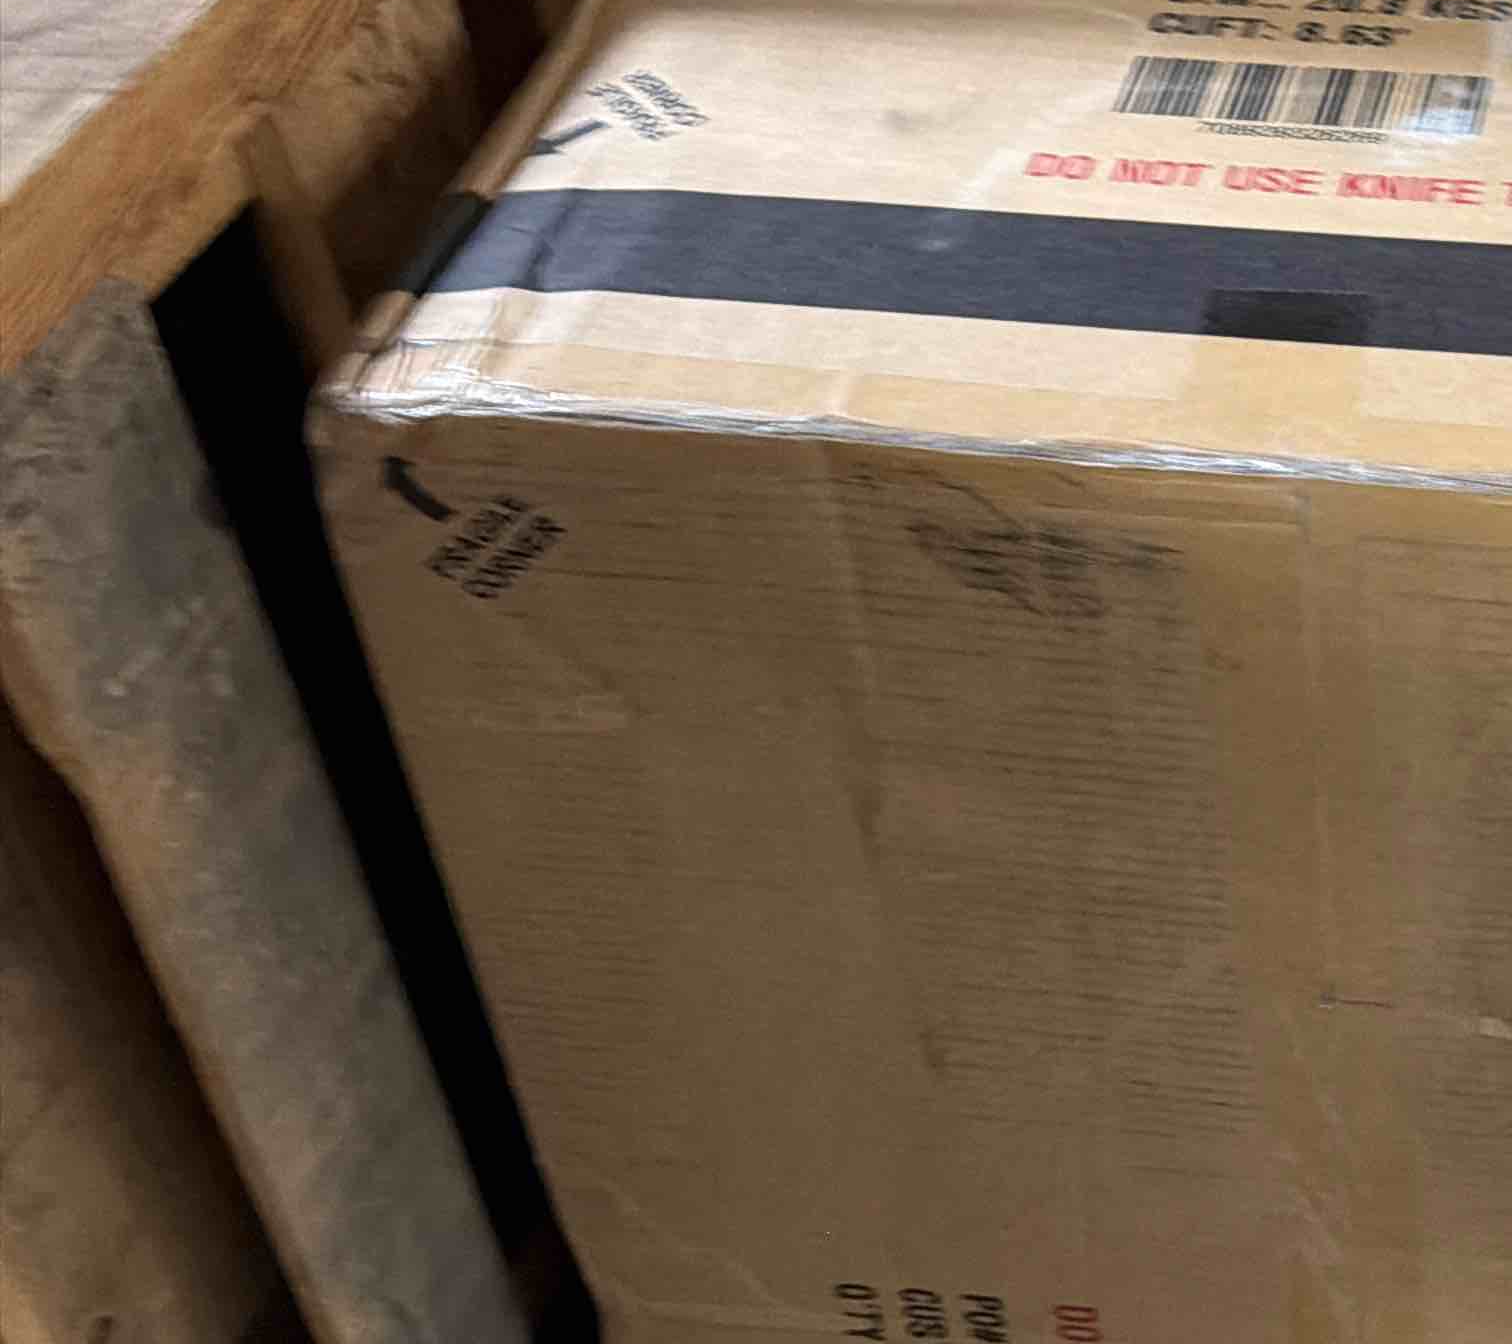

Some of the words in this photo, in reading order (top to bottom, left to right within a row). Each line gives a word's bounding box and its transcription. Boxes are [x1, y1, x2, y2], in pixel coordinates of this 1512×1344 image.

[1024, 152, 1097, 179] DO
[1108, 157, 1214, 186] NOT
[1222, 164, 1327, 195] USE
[1336, 171, 1488, 206] KNIFE
[1052, 1304, 1103, 1343] DO
